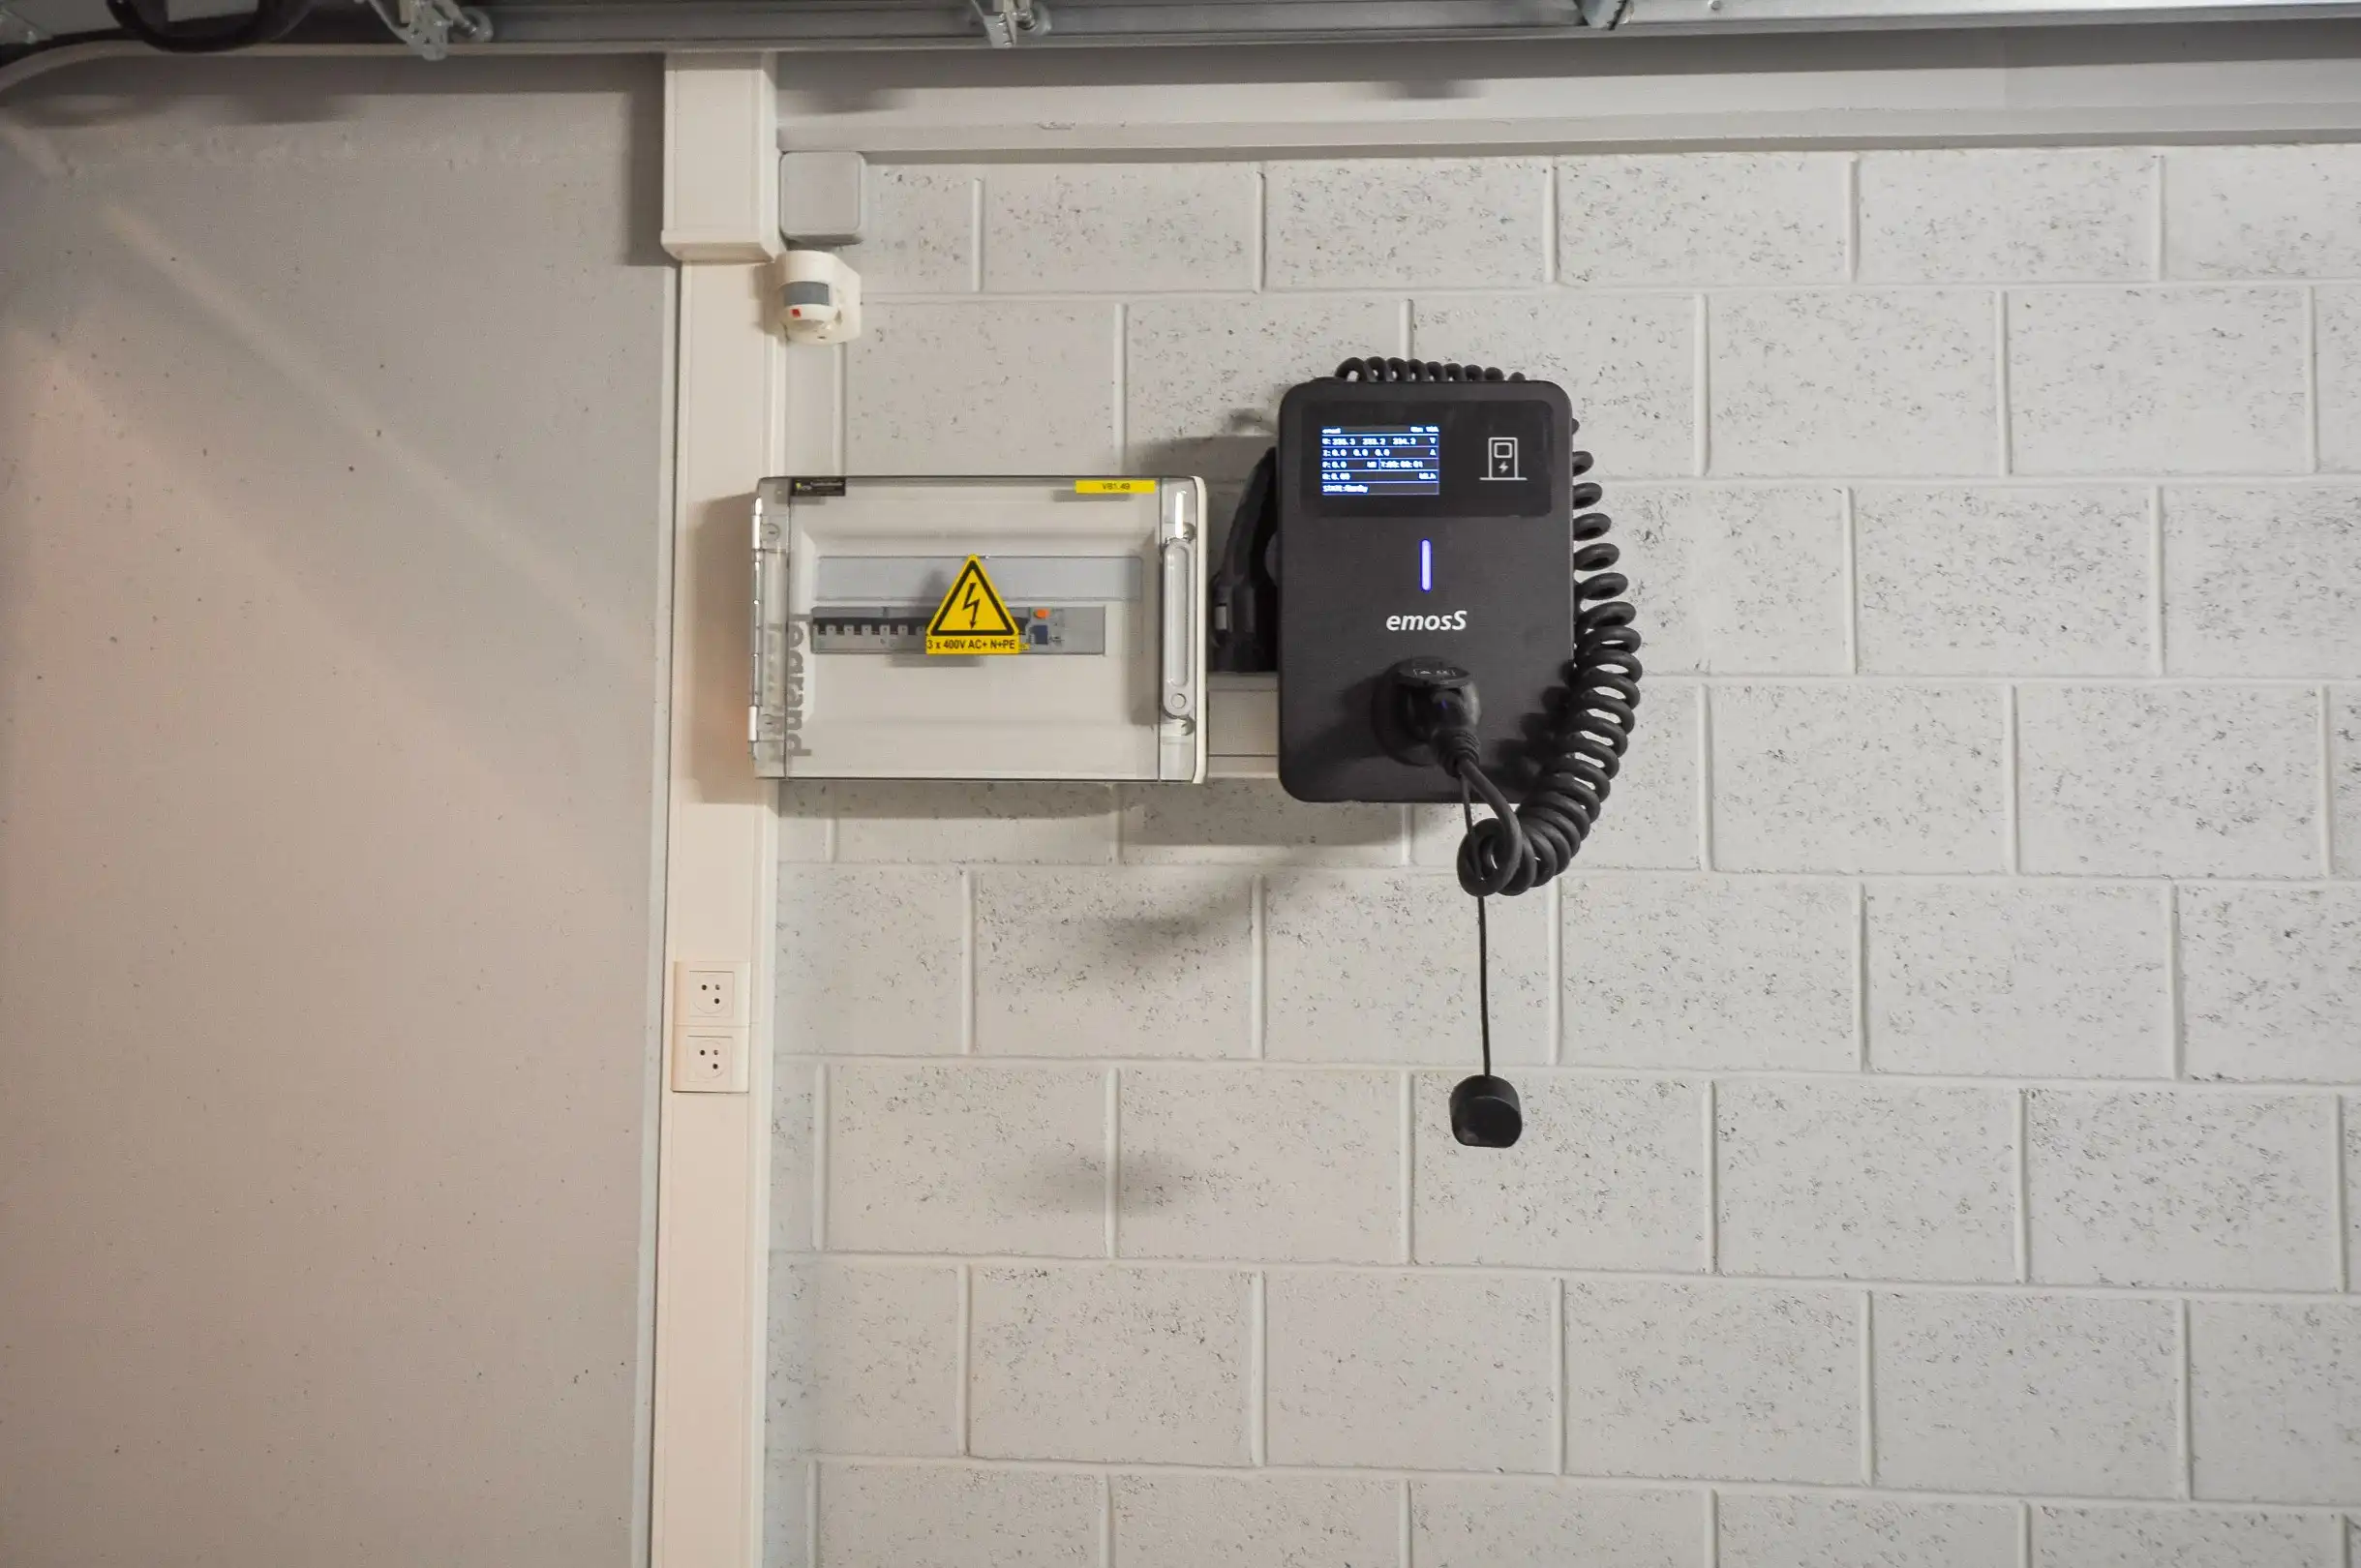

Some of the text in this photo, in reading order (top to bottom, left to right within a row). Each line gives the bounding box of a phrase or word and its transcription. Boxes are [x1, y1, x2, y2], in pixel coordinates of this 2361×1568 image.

[1386, 610, 1468, 631] emosS
[927, 640, 933, 649] 3
[943, 640, 965, 648] 400V
[989, 640, 1014, 648] N+PE
